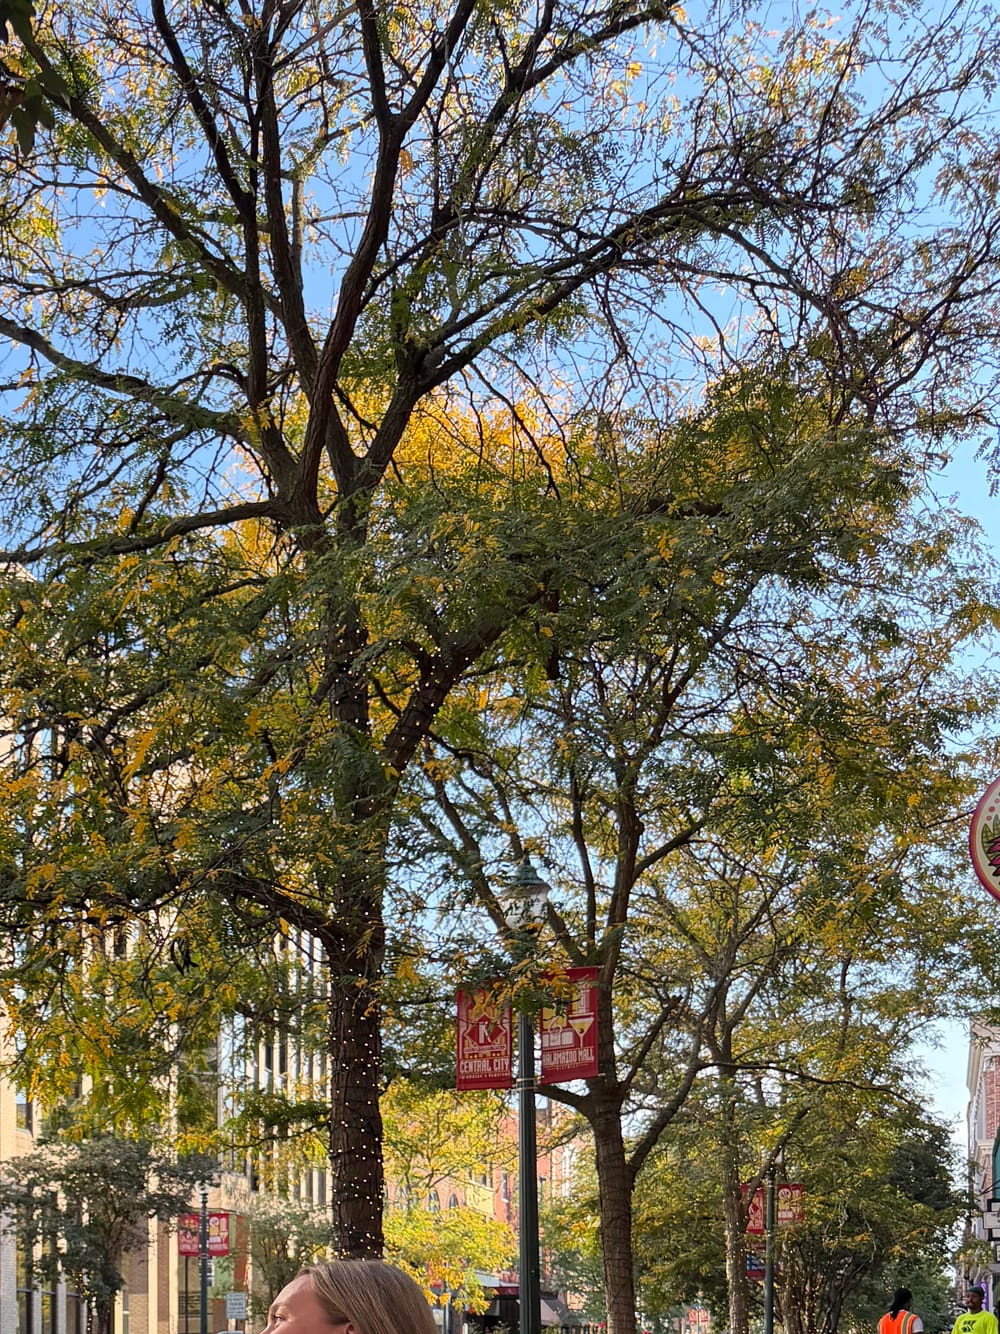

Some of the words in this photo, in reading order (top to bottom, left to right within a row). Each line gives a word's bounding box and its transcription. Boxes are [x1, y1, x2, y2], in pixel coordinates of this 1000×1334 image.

[478, 1021, 492, 1045] K
[578, 1047, 595, 1062] MALL
[459, 1059, 492, 1073] CENTRAL
[493, 1057, 510, 1071] CITY
